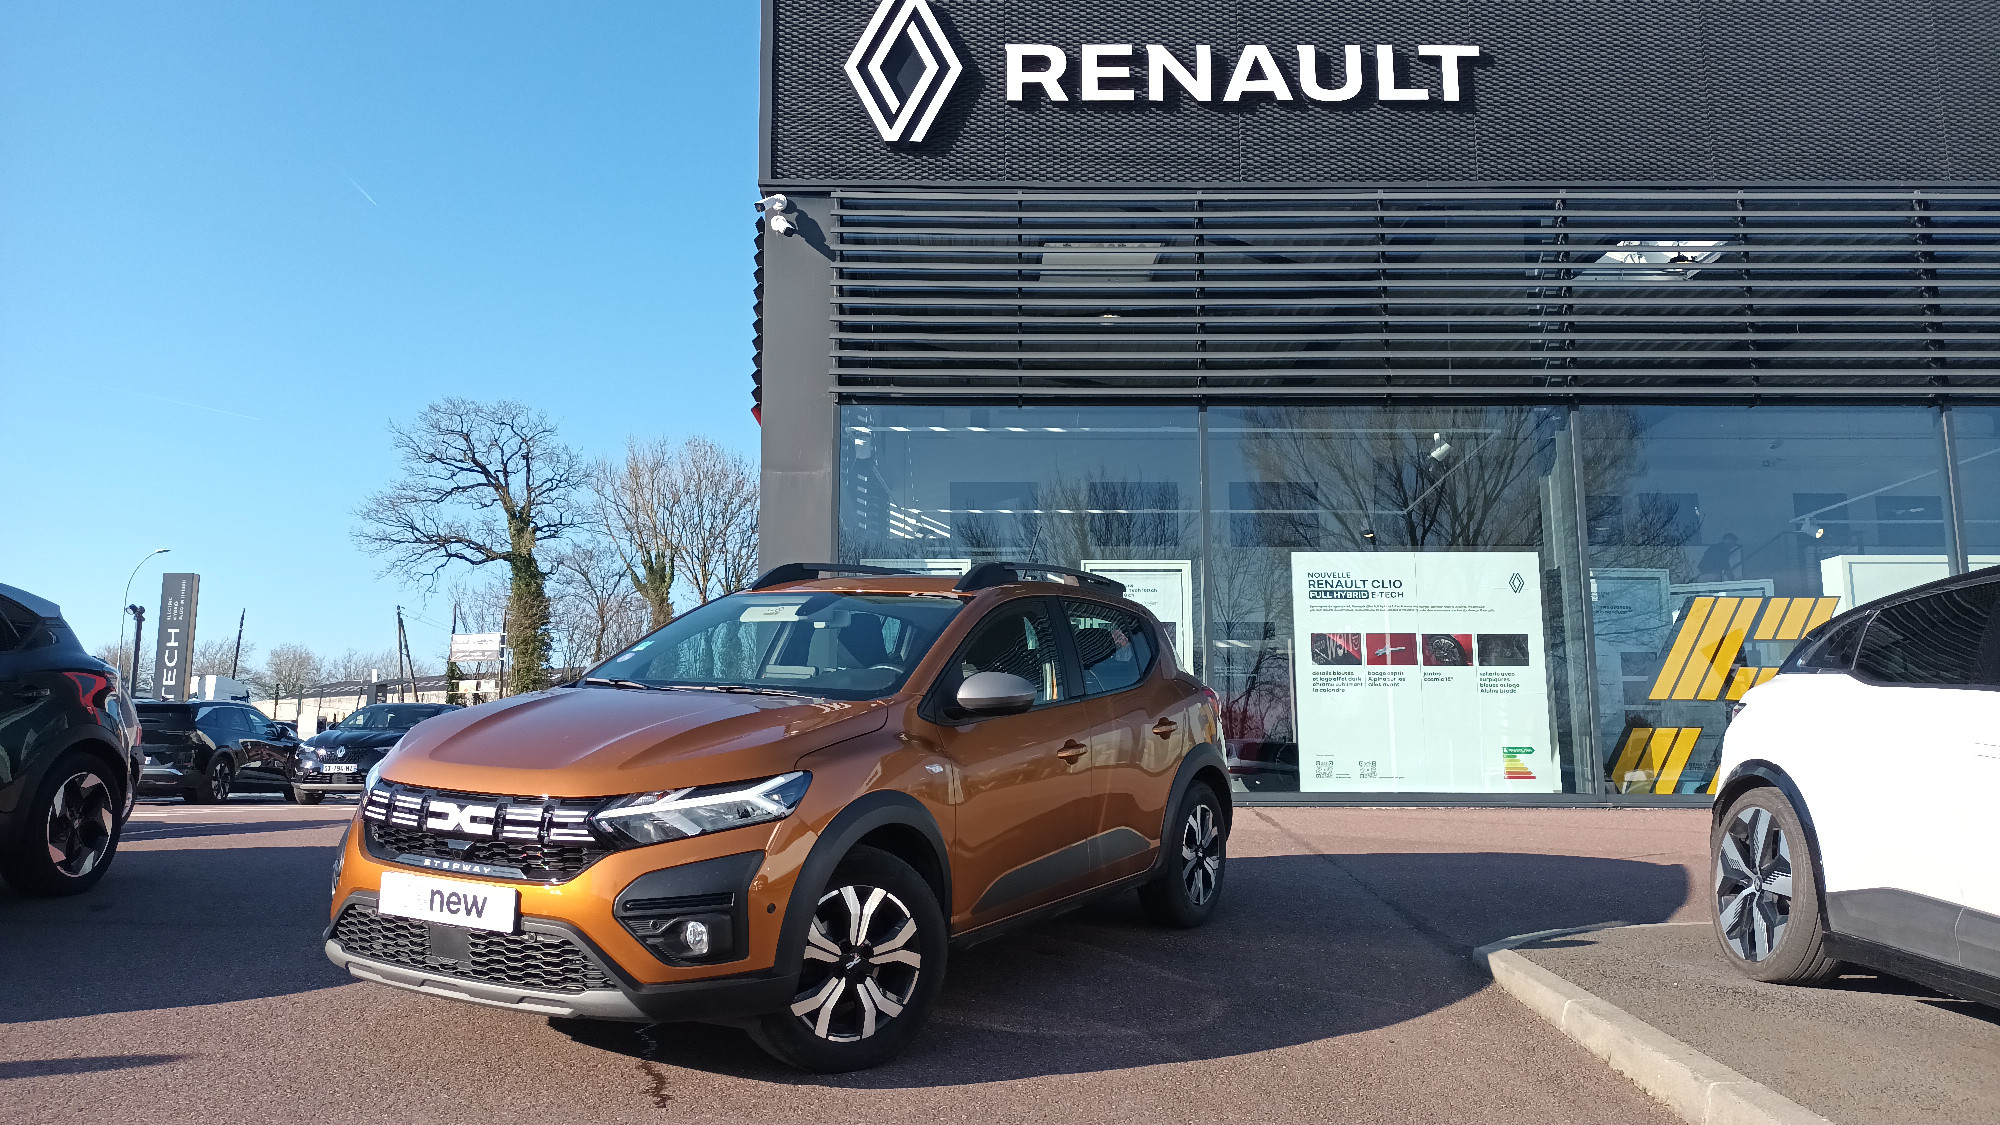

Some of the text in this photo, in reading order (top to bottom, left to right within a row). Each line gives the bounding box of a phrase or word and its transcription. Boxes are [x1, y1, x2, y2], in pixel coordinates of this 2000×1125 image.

[1004, 43, 1480, 102] RENAULT
[1309, 580, 1402, 588] RENAULT CLIO
[1310, 591, 1333, 599] FULL
[1334, 591, 1368, 599] HYBRID
[423, 858, 491, 874] STEPWAY
[429, 888, 488, 919] new
